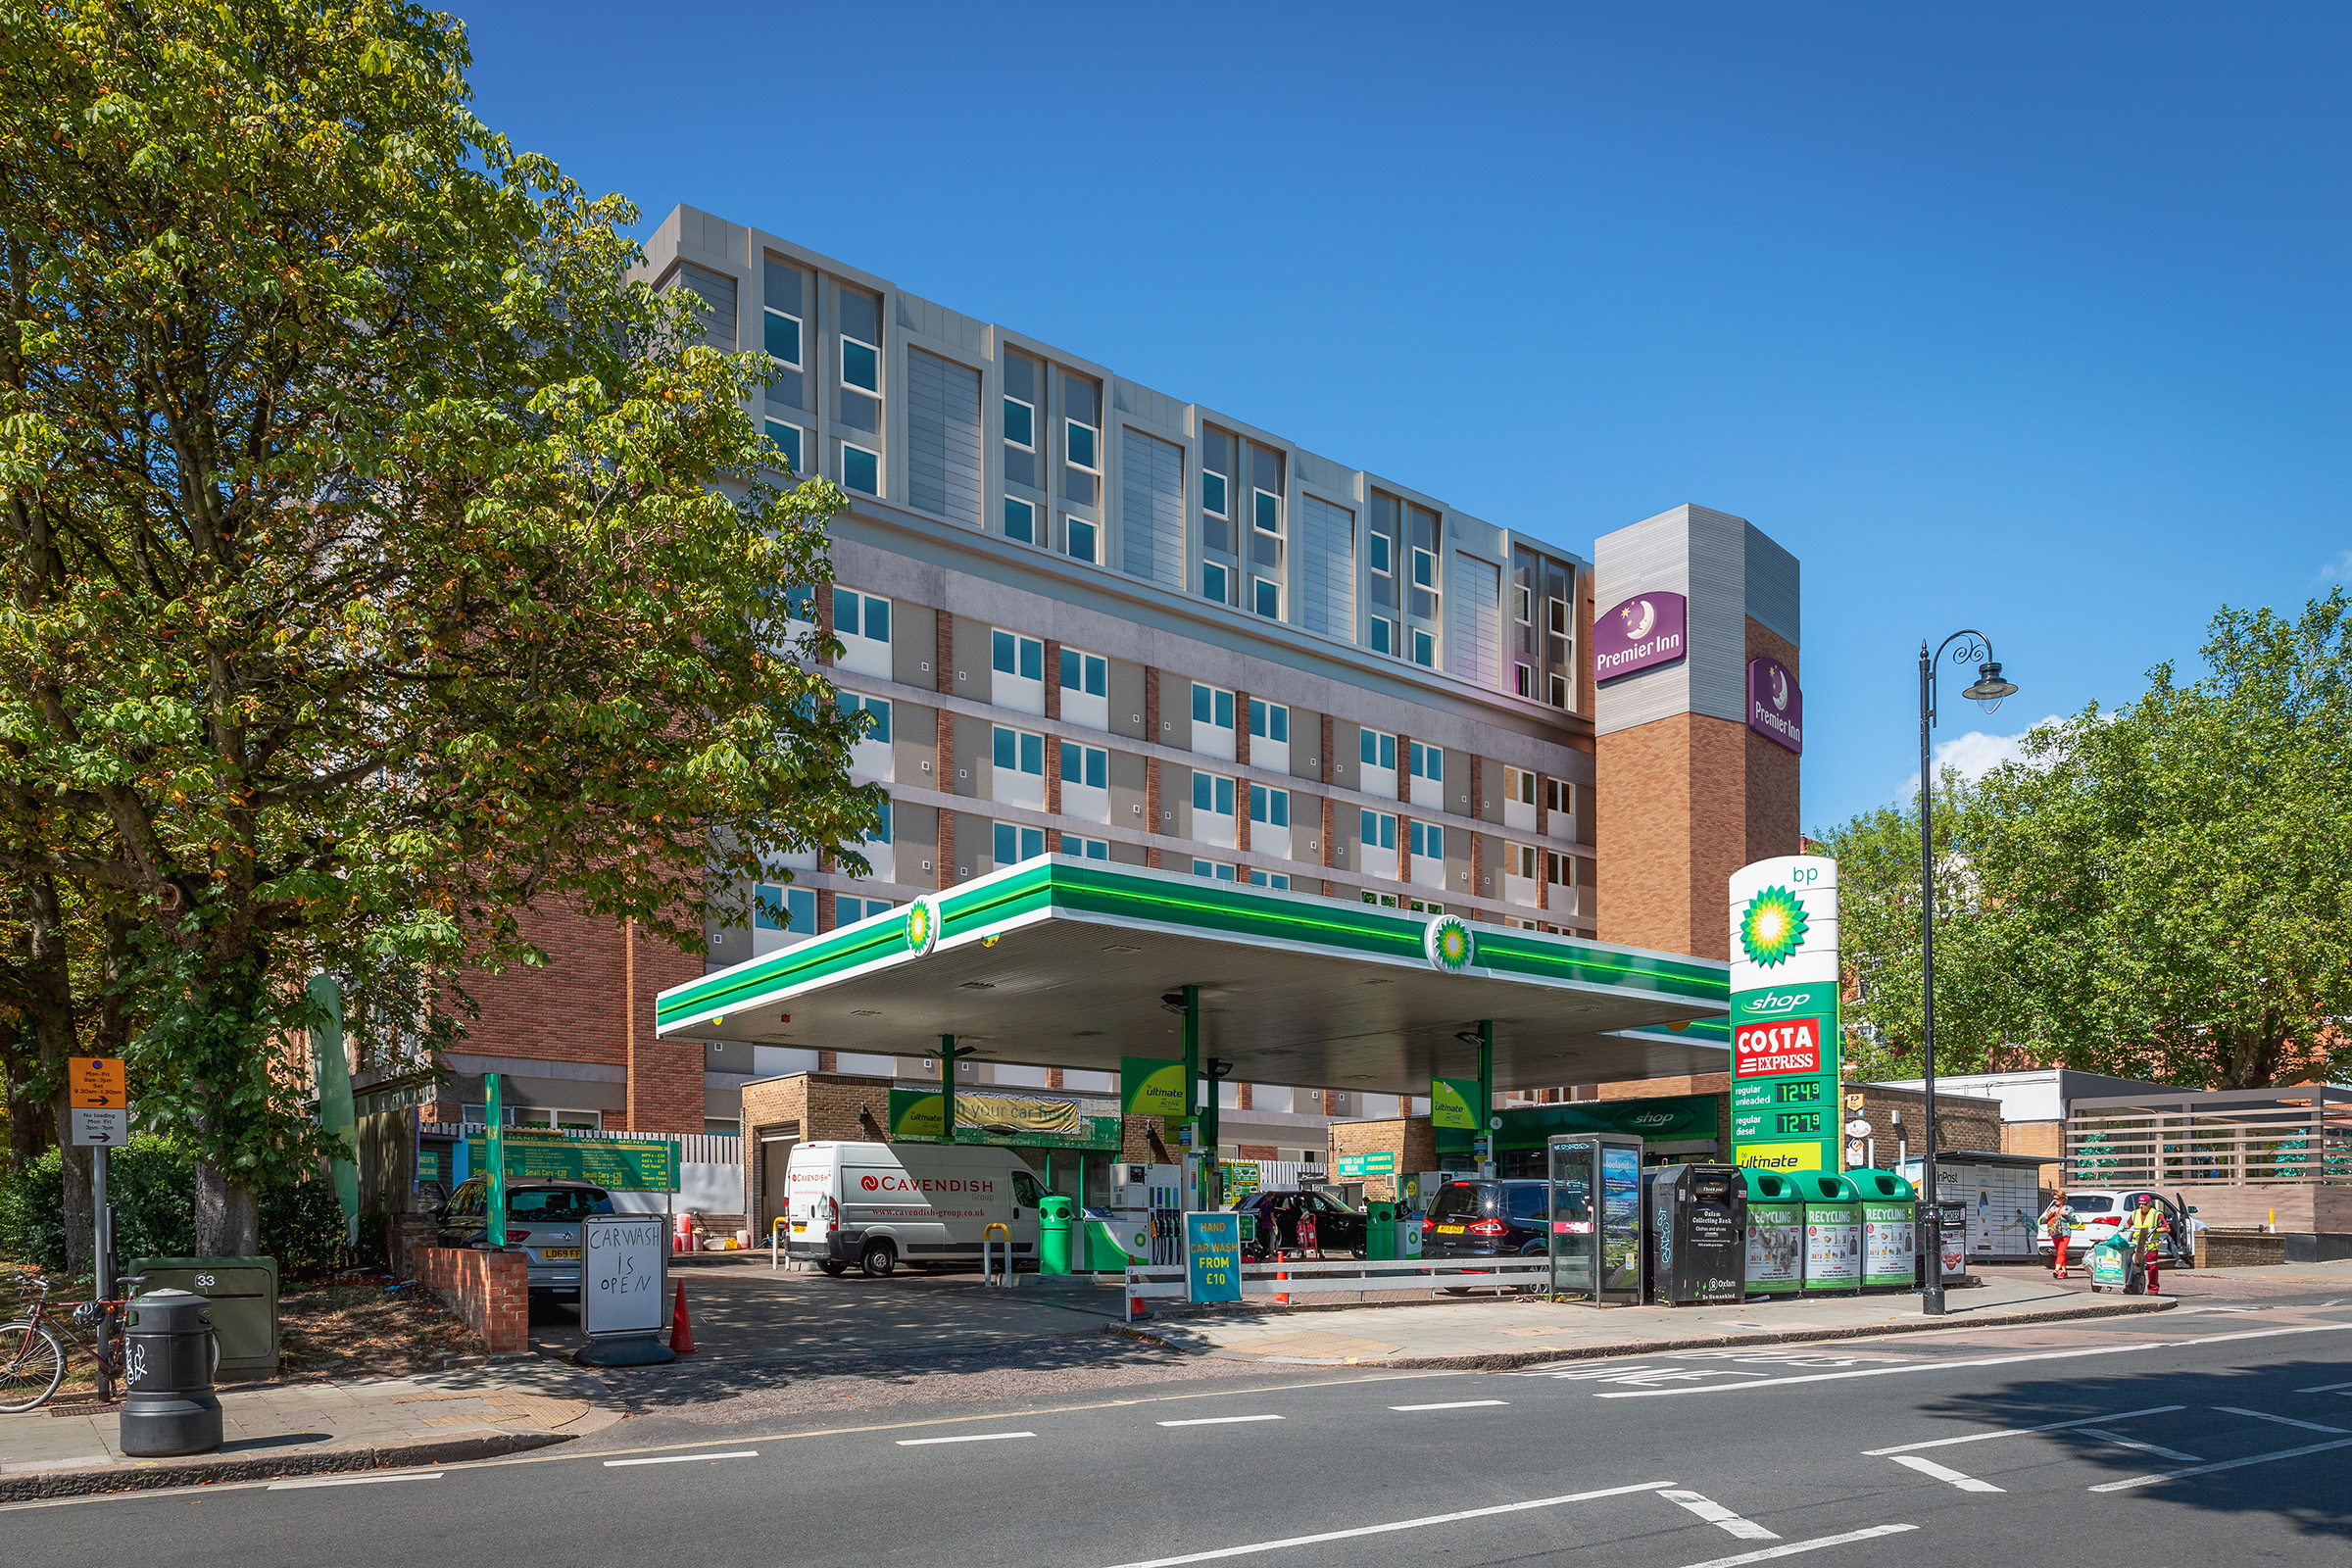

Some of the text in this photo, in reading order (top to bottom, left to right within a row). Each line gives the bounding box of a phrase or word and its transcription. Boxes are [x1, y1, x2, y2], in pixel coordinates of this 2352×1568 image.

[1597, 634, 1679, 671] Premier Inn
[1756, 701, 1800, 742] Premier Inn
[1793, 866, 1818, 885] bp
[1751, 992, 1811, 1012] shop
[1738, 1026, 1813, 1054] COSTA
[1757, 1053, 1813, 1072] EXPRESS
[1147, 1087, 1183, 1098] ultimate
[1735, 1085, 1761, 1096] regular
[1782, 1083, 1819, 1102] 124.9
[1735, 1095, 1770, 1105] unleaded
[971, 1103, 1004, 1119] your
[1011, 1106, 1034, 1119] car
[1039, 1106, 1071, 1122] here
[1435, 1103, 1463, 1113] ultimate
[910, 1113, 942, 1122] ultimate
[1636, 1112, 1674, 1126] shop
[1736, 1115, 1761, 1126] regular
[1783, 1114, 1819, 1132] 127.9
[1736, 1126, 1755, 1136] diesel
[1606, 1160, 1629, 1170] Iceland
[1741, 1154, 1798, 1169] ultimate
[881, 1176, 993, 1192] CAVENDISH
[972, 1193, 994, 1201] Group
[872, 1208, 985, 1218] www.cavendish-group.co.uk
[1749, 1211, 1791, 1224] RECYCLING
[1809, 1210, 1850, 1223] RECYCLING
[1866, 1208, 1905, 1220] RECYCLING
[1944, 1210, 1959, 1221] SHOES
[1200, 1222, 1225, 1232] HAND
[1190, 1242, 1238, 1253] CAR WASH
[1199, 1257, 1229, 1269] FROM
[197, 1276, 215, 1286] 33
[601, 1275, 651, 1294] OPEN
[1206, 1273, 1225, 1284] £10
[1666, 1350, 1910, 1367] BUS
[1496, 1363, 1769, 1386] LANE
